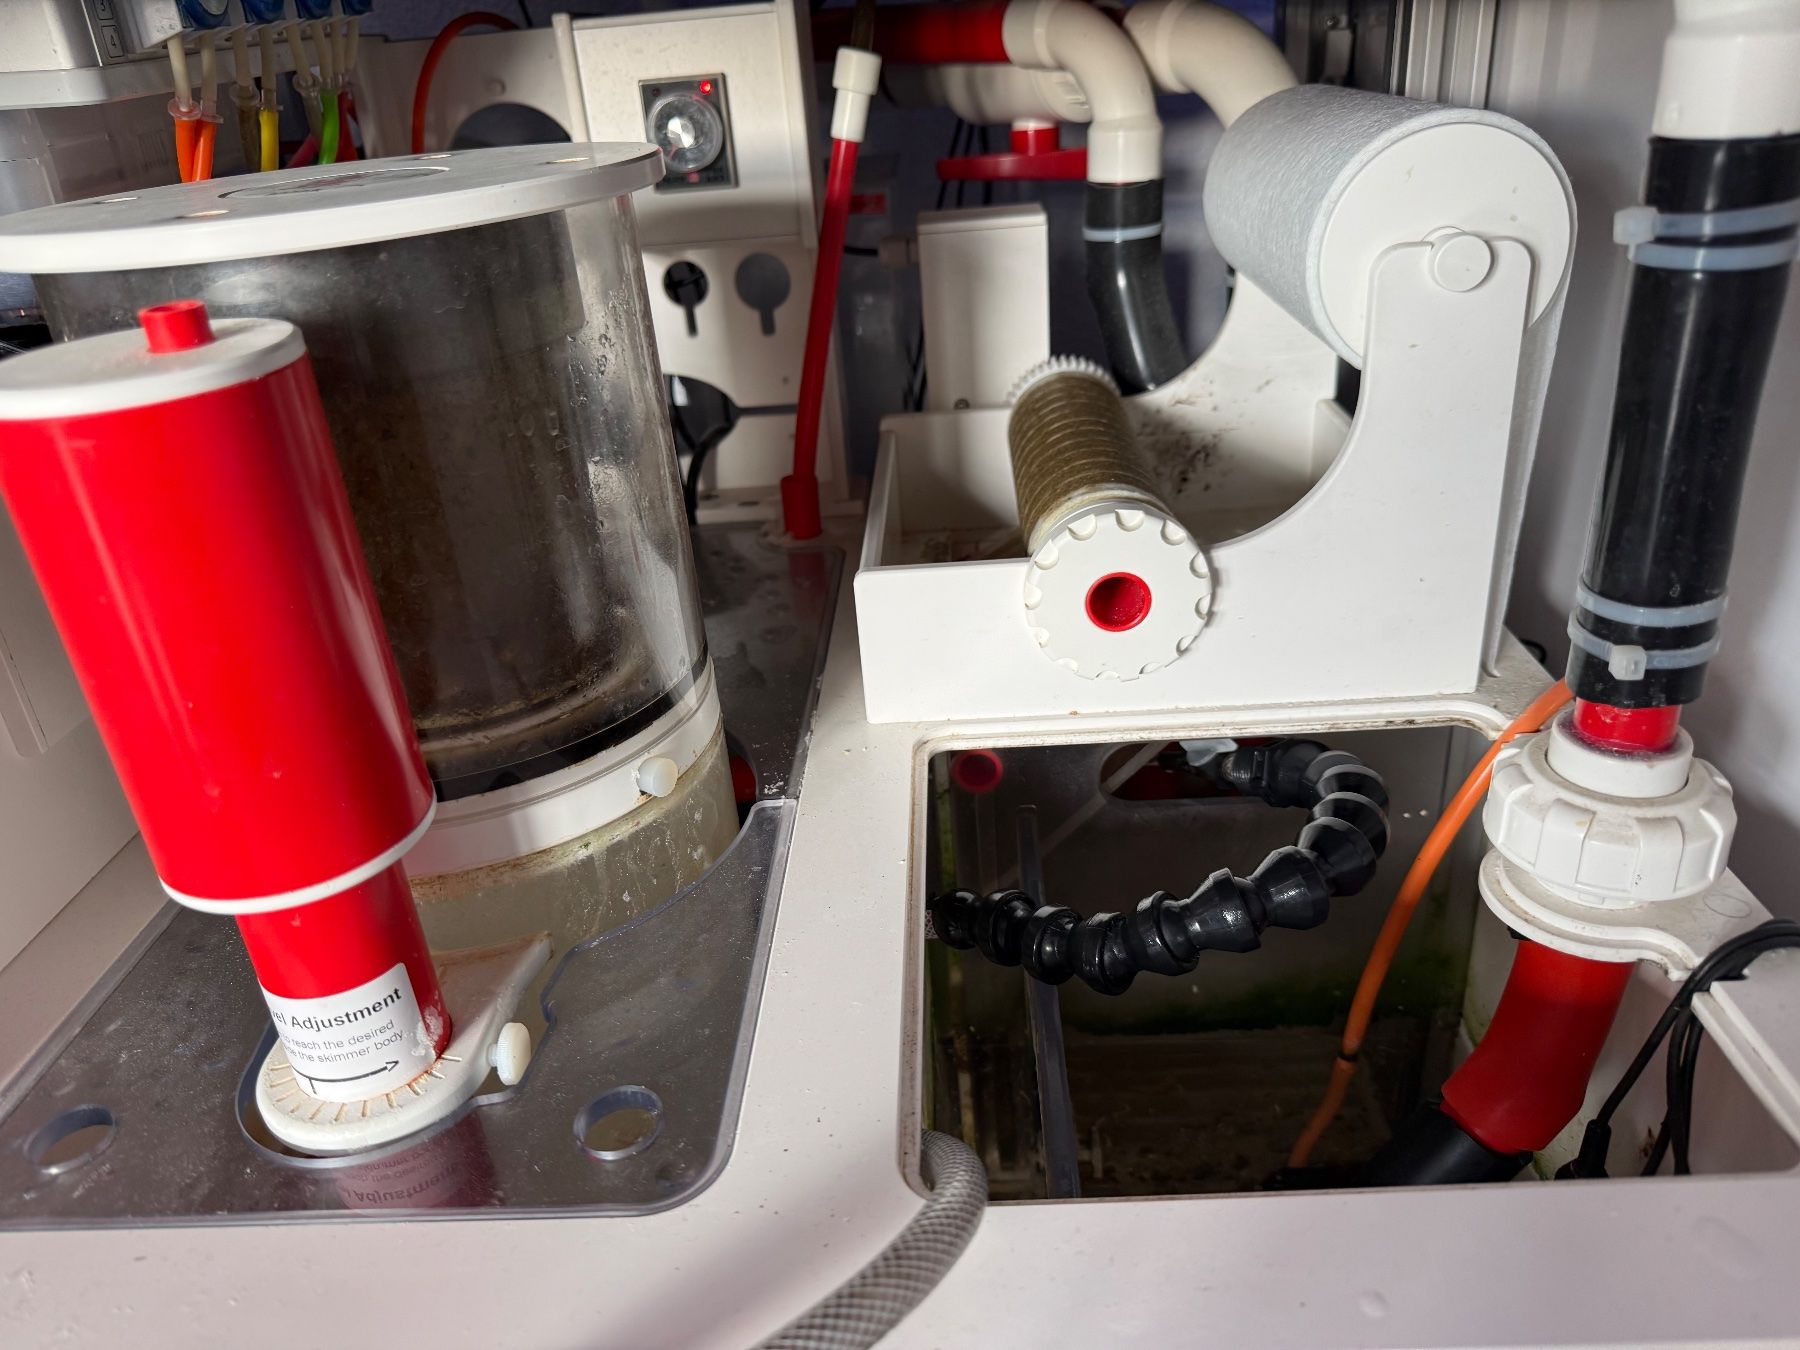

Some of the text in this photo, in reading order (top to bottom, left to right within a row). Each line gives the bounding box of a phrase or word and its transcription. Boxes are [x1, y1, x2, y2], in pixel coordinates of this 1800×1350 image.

[291, 988, 402, 1032] Adjustment
[291, 1038, 321, 1050] reach
[323, 1038, 344, 1049] the
[348, 1019, 394, 1045] desired
[298, 1050, 314, 1062] the
[318, 1045, 370, 1063] skimmer
[374, 1030, 404, 1051] body
